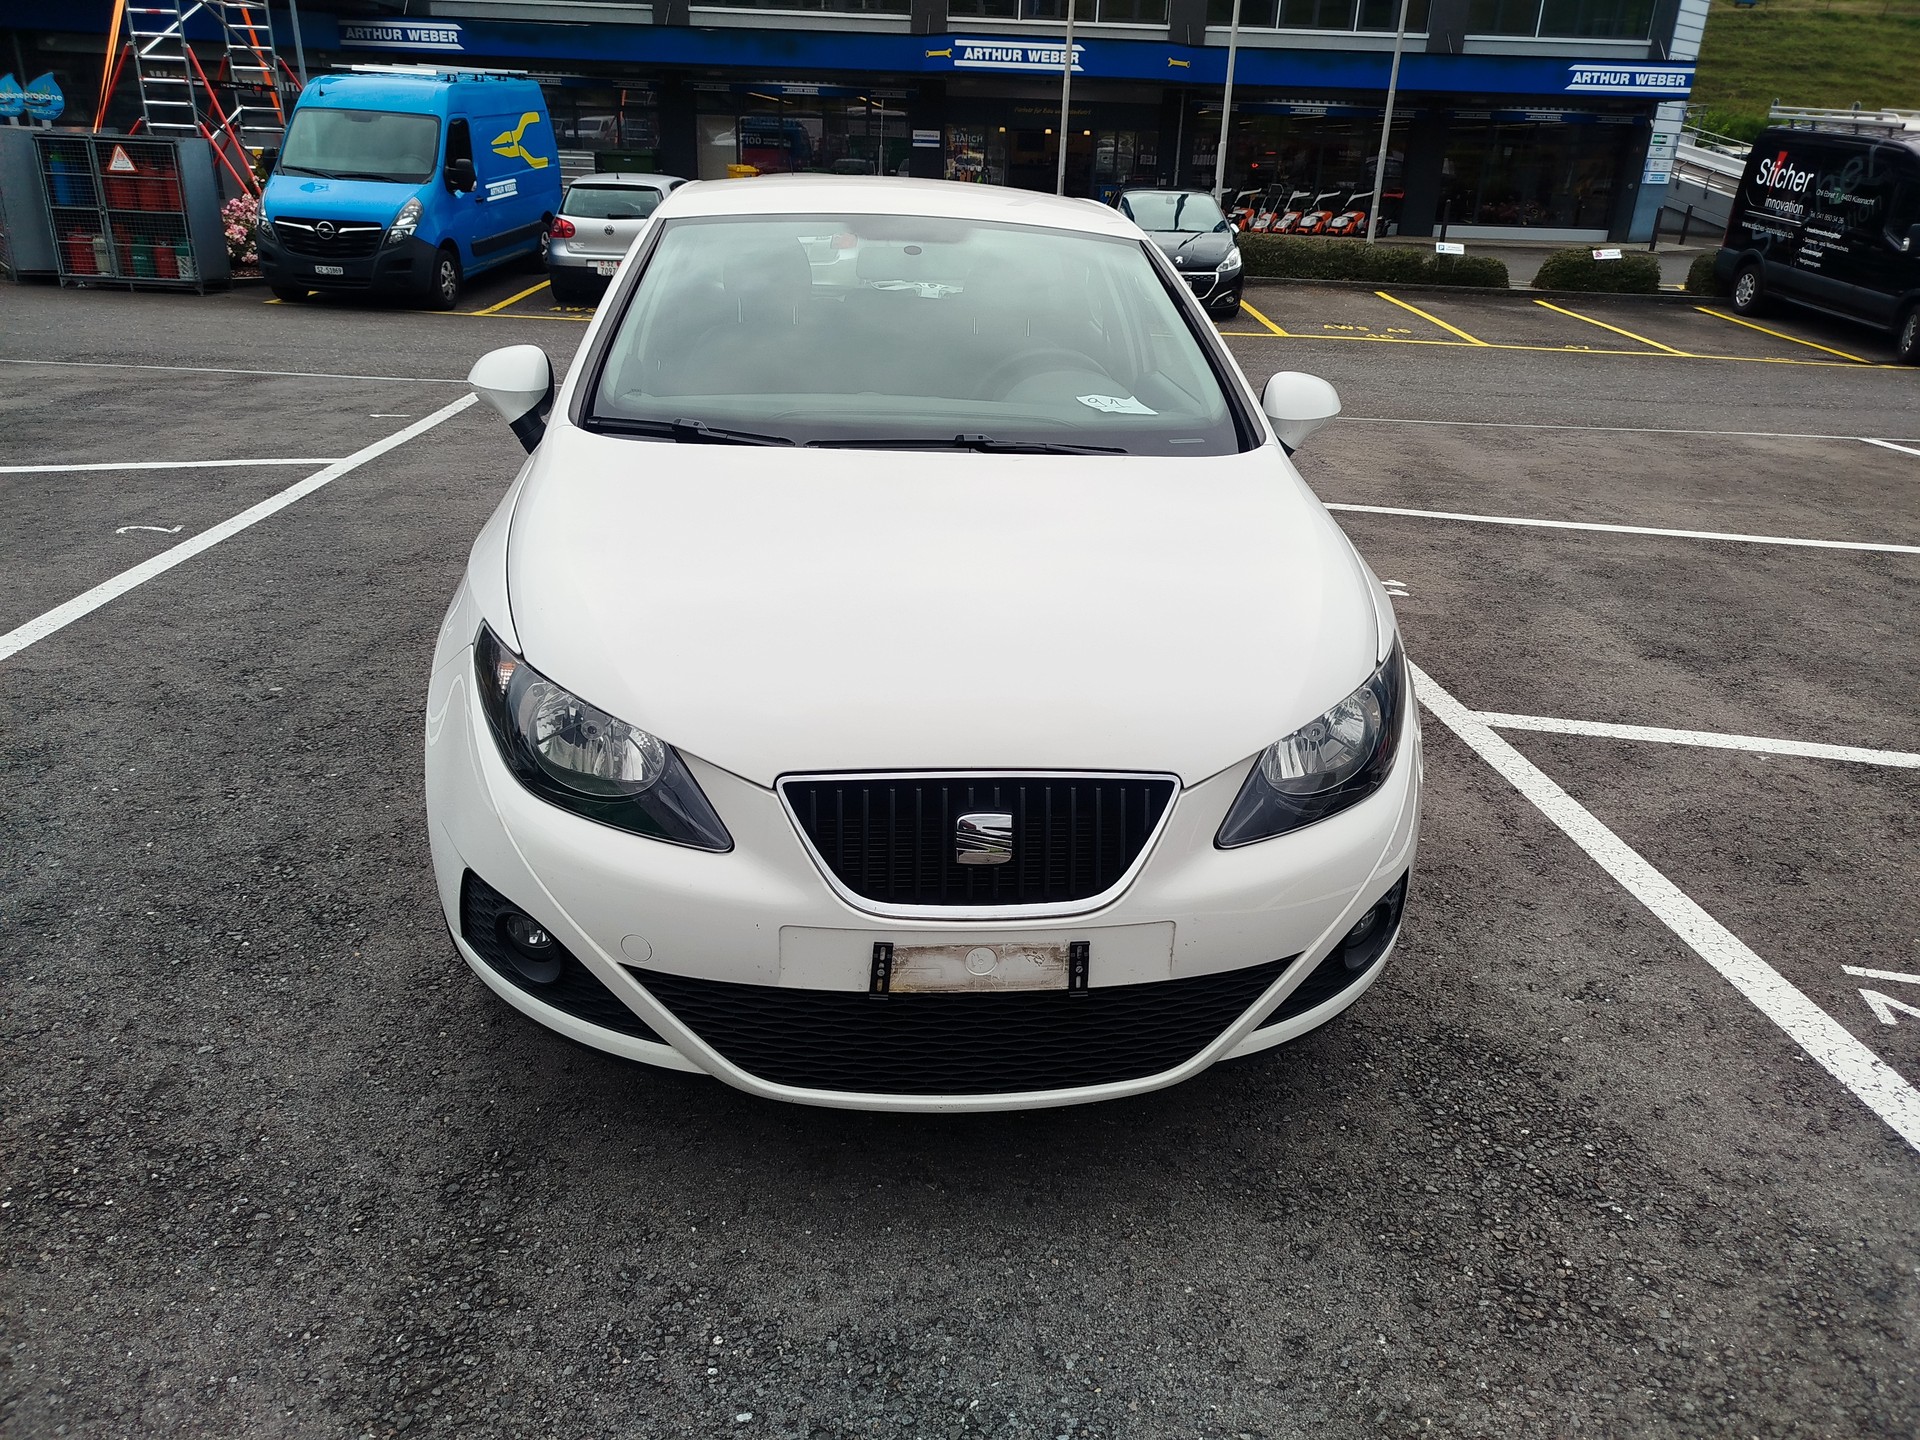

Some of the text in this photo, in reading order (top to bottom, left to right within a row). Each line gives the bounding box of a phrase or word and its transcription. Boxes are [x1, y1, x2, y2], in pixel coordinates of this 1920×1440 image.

[346, 28, 458, 42] ARTHUR WEBER
[963, 47, 1079, 64] ARTHUR WEBER
[1571, 71, 1686, 86] ARTHUR WEBER
[24, 92, 63, 101] propane
[1756, 157, 1815, 193] Sticher
[1764, 194, 1804, 215] innovation
[601, 267, 618, 276] 7097
